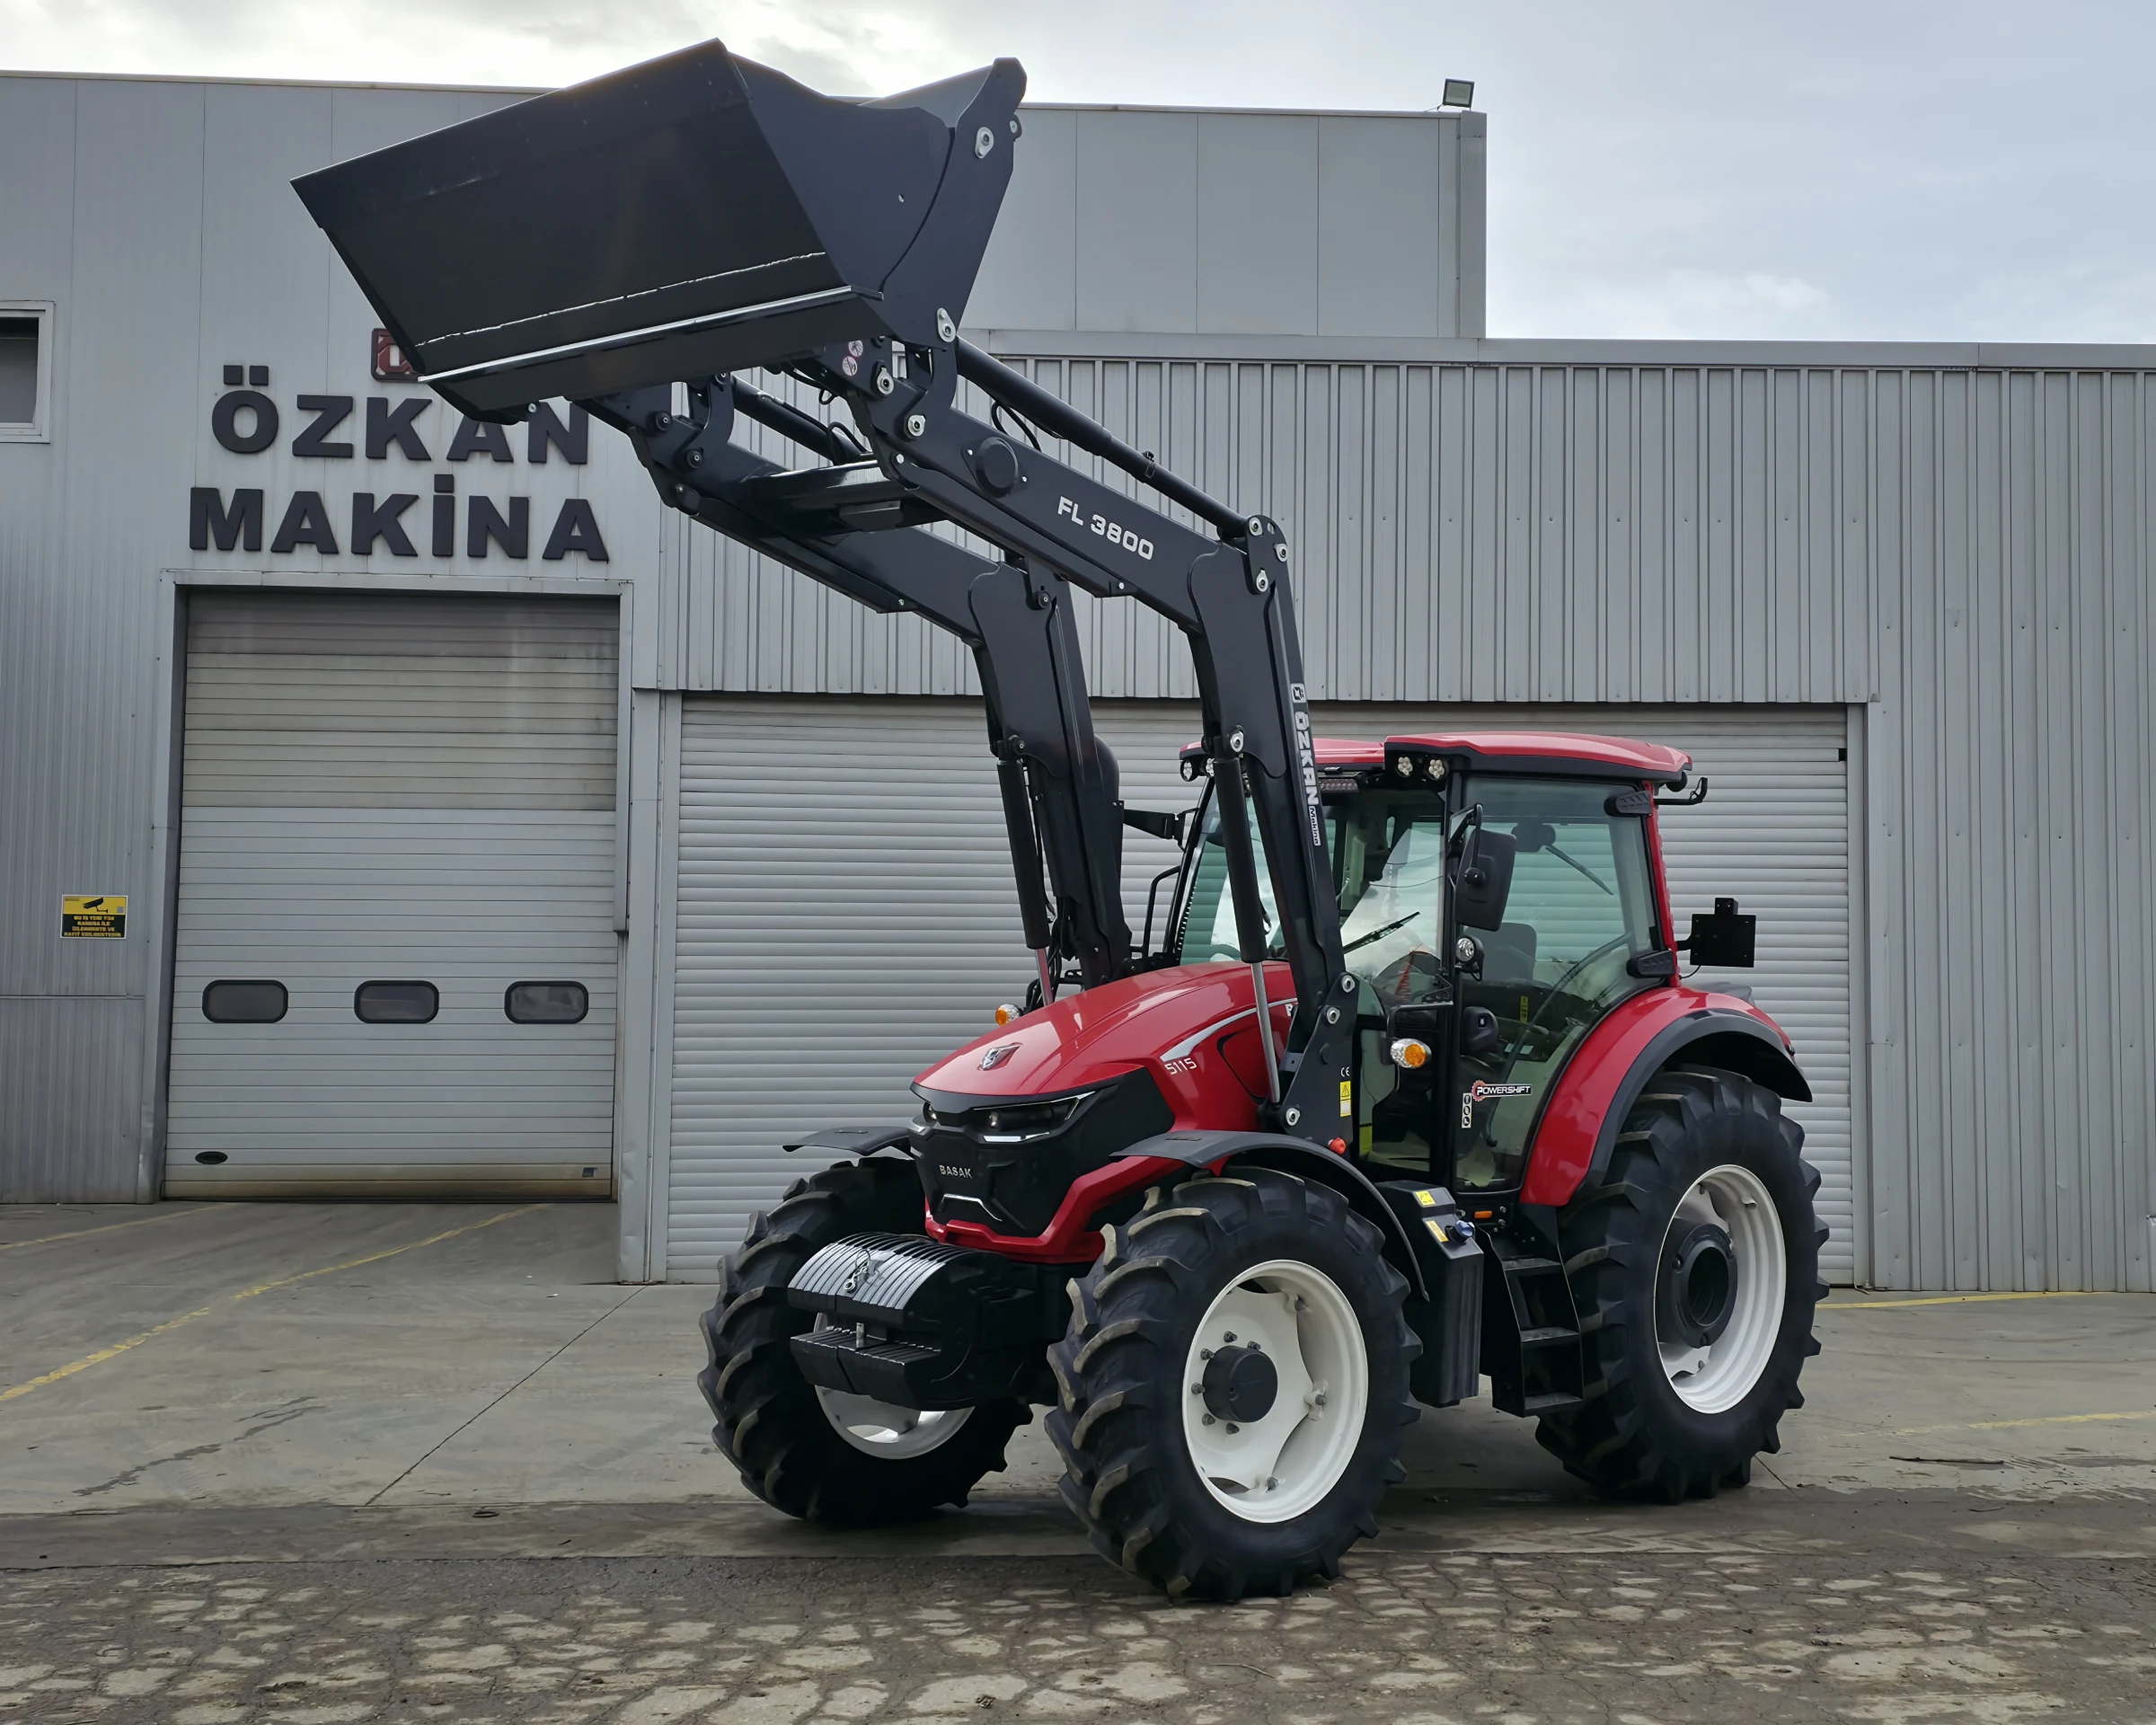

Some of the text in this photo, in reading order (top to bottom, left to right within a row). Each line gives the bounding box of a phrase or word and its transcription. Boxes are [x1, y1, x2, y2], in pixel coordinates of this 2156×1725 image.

[211, 365, 589, 465] ÖZKAN
[189, 473, 609, 563] MAKİNA
[1057, 496, 1154, 560] FL 3800
[1309, 806, 1321, 845] Makina
[1164, 1057, 1197, 1075] 5115
[1476, 1085, 1531, 1096] POWERSHIFT
[939, 1164, 973, 1180] BASAK
